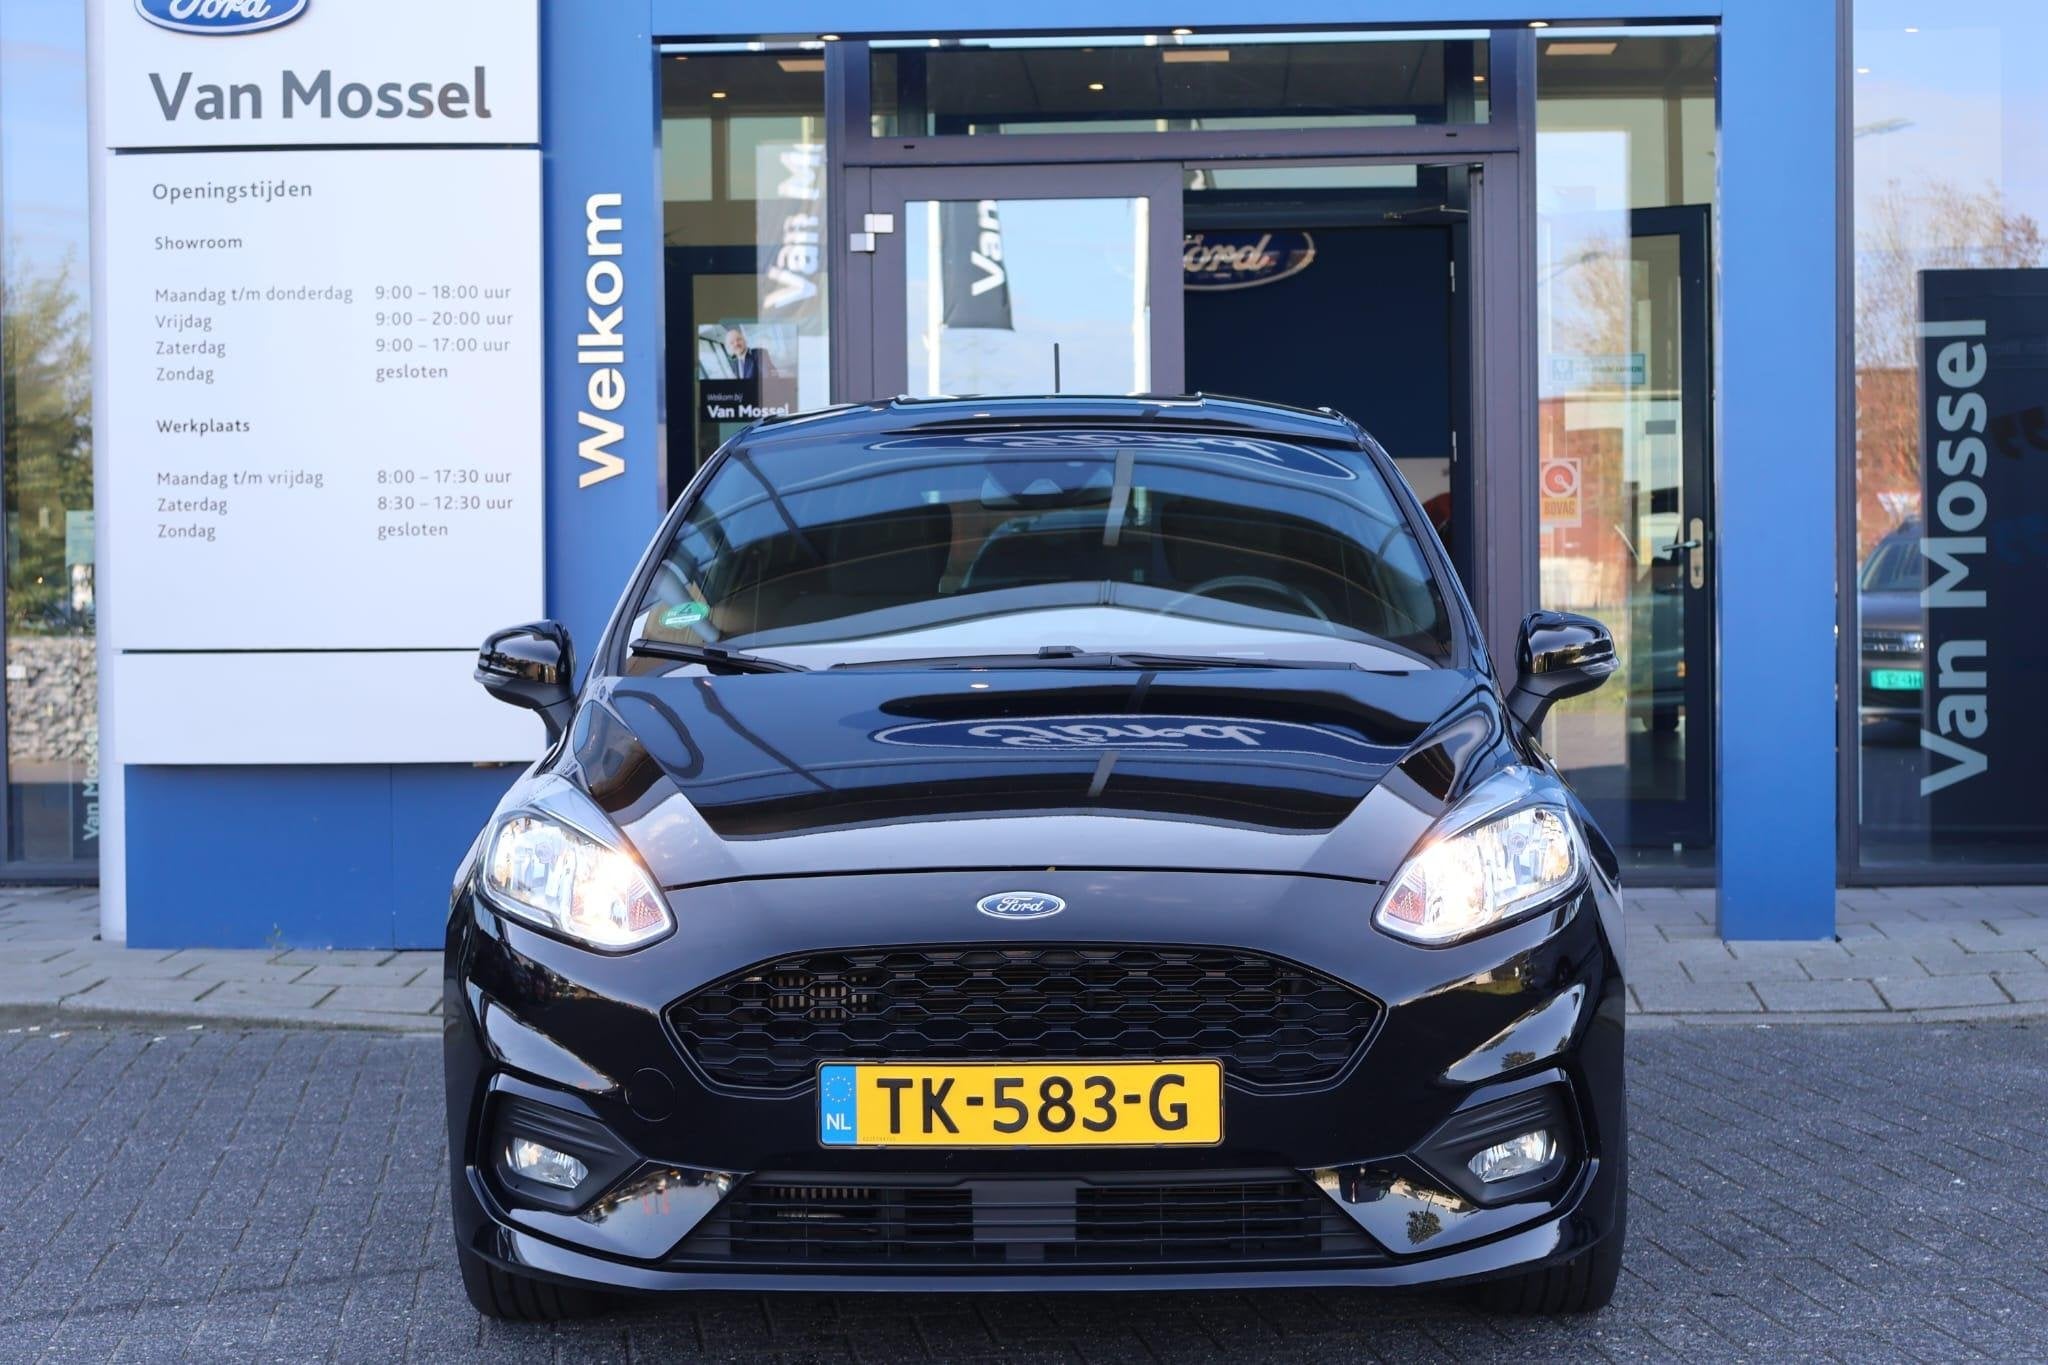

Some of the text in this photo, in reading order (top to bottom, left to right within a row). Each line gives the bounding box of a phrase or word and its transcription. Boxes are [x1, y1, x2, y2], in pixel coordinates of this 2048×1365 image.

[148, 66, 493, 121] Van Mossel
[152, 180, 313, 205] Openingstijden
[154, 235, 243, 251] Showroom
[970, 200, 1005, 297] Van
[1184, 233, 1276, 272] ord
[763, 213, 819, 309] Van
[155, 287, 227, 306] Maandag
[231, 287, 260, 304] t/m
[266, 284, 354, 305] donderdag
[375, 285, 413, 301] 9:00
[432, 284, 479, 300] 18:00
[484, 287, 512, 300] uur
[154, 313, 213, 333] Vrijdag
[375, 312, 413, 327] 9:00
[431, 311, 481, 327] 20:00
[485, 314, 513, 326] uur
[155, 339, 227, 359] Zaterdag
[375, 338, 413, 353] 9:00
[432, 337, 478, 353] 17:00
[483, 340, 511, 353] uur
[577, 192, 626, 489] Welkom
[156, 363, 449, 385] Zondag gesloten
[707, 403, 789, 418] Van Mossel
[156, 418, 251, 437] Werkplaats
[156, 470, 228, 490] Maandag
[232, 470, 263, 486] t/m
[268, 469, 324, 489] vrijdag
[377, 470, 415, 485] 8:00
[434, 468, 480, 484] 17:30
[485, 471, 513, 484] uur
[157, 496, 228, 516] Zaterdag
[377, 496, 415, 511] 8:30
[434, 495, 481, 511] 12:30
[486, 498, 513, 510] uur
[157, 521, 449, 542] Zondag gesloten
[1917, 319, 1989, 798] Van Mossel
[82, 801, 99, 840] Van
[996, 896, 1045, 912] Ford
[876, 1073, 1189, 1134] TK-583-G
[826, 1113, 852, 1131] NL
